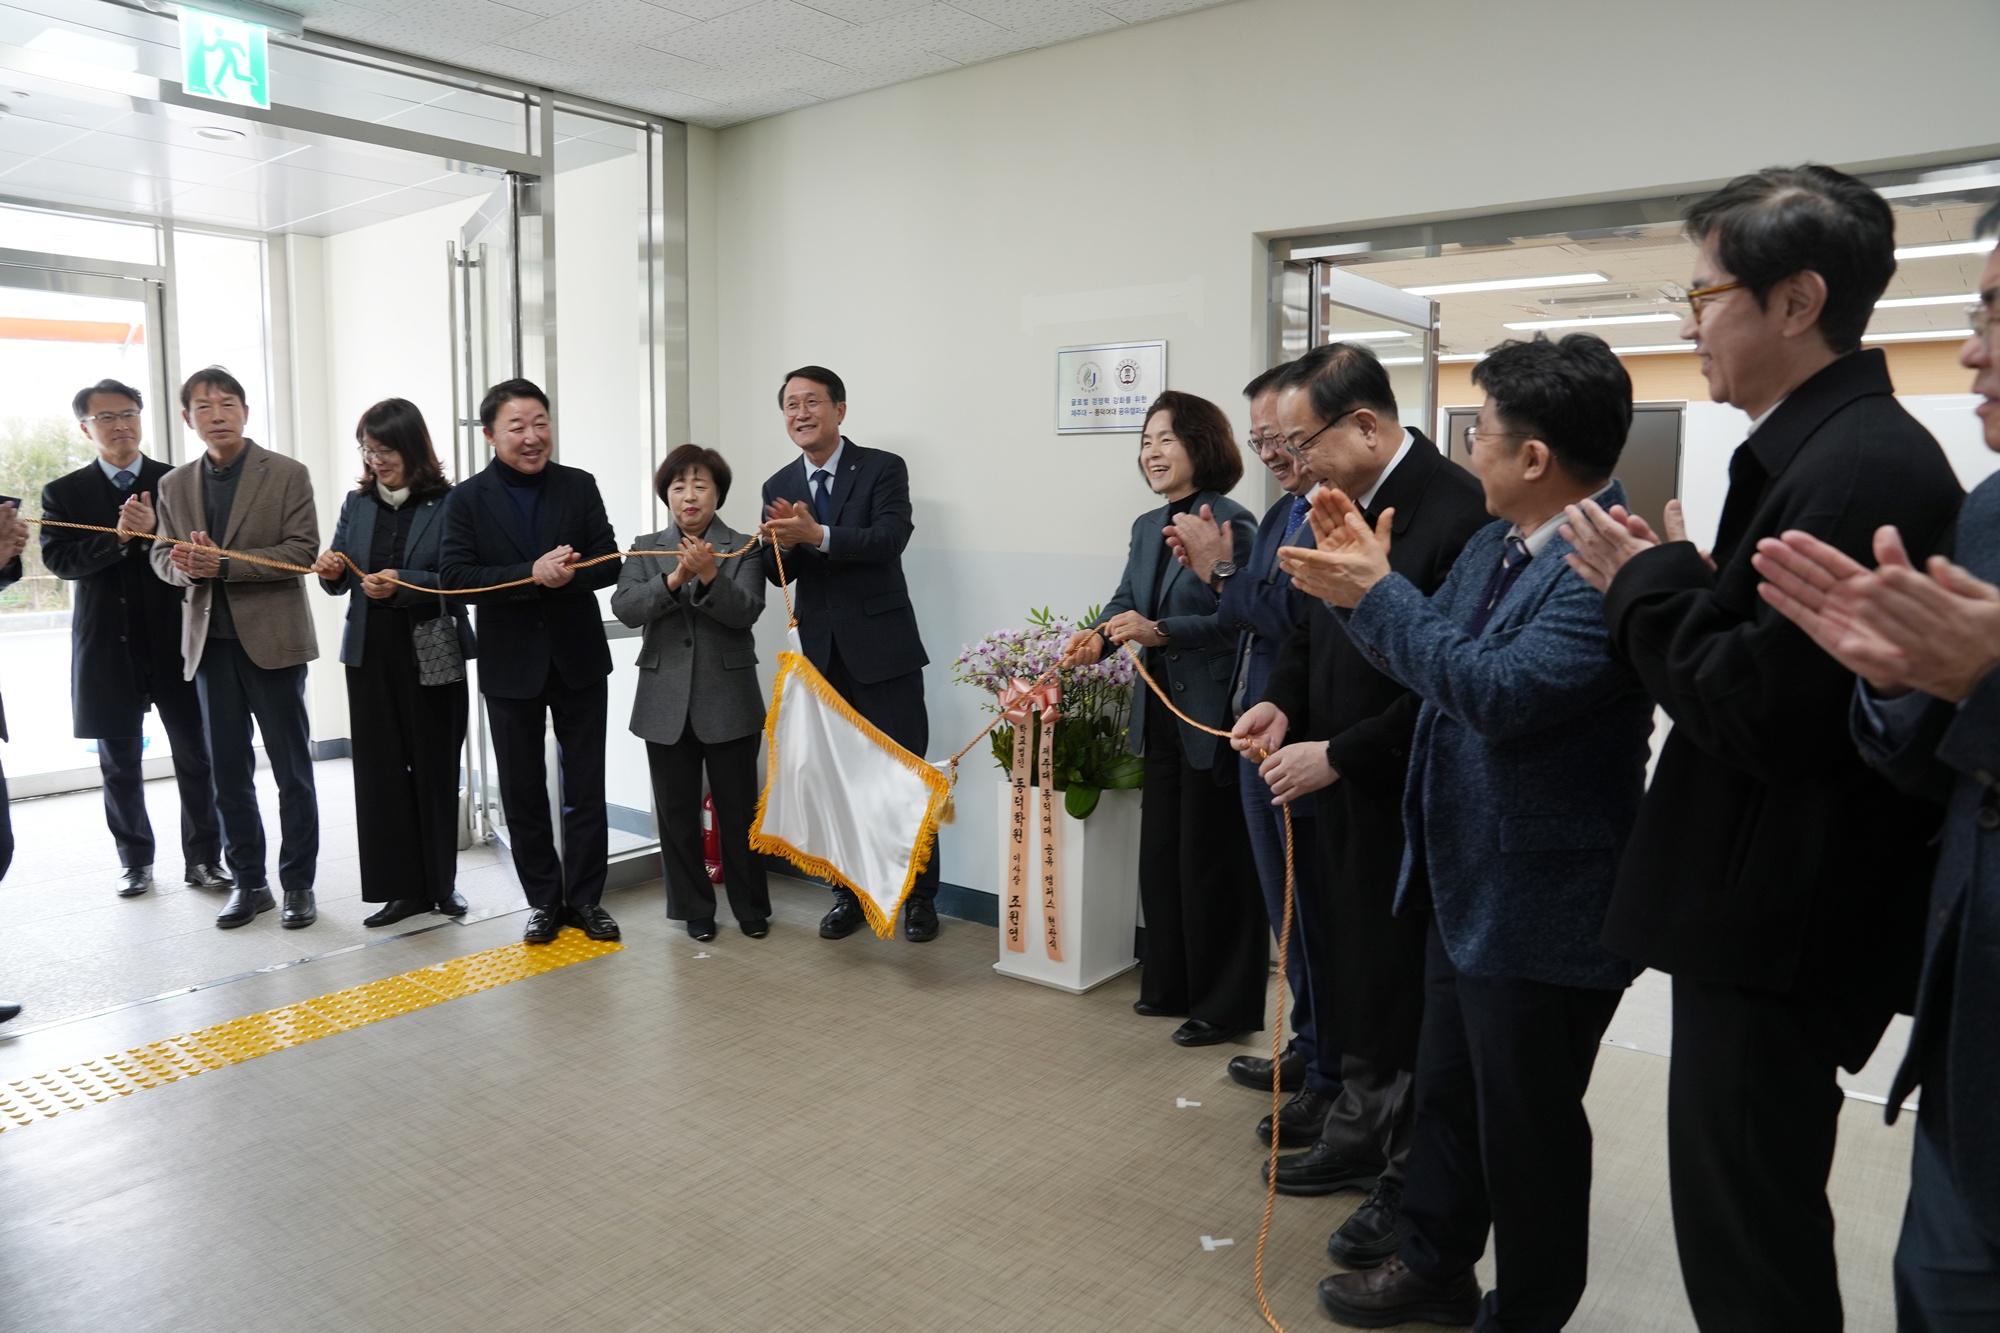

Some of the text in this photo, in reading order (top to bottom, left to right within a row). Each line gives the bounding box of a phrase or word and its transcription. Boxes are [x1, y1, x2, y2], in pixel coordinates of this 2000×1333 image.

[1071, 395, 1147, 406] 글로벌 경쟁력 강화를 위한
[1094, 408, 1116, 416] 동덕여대
[1118, 407, 1147, 415] 공유캠퍼스
[1008, 724, 1027, 942] 학교법인 동덕학원 이사장 조원영
[1042, 727, 1058, 951] 축 제주대 동덕여대 공유 캠퍼스 현판식
